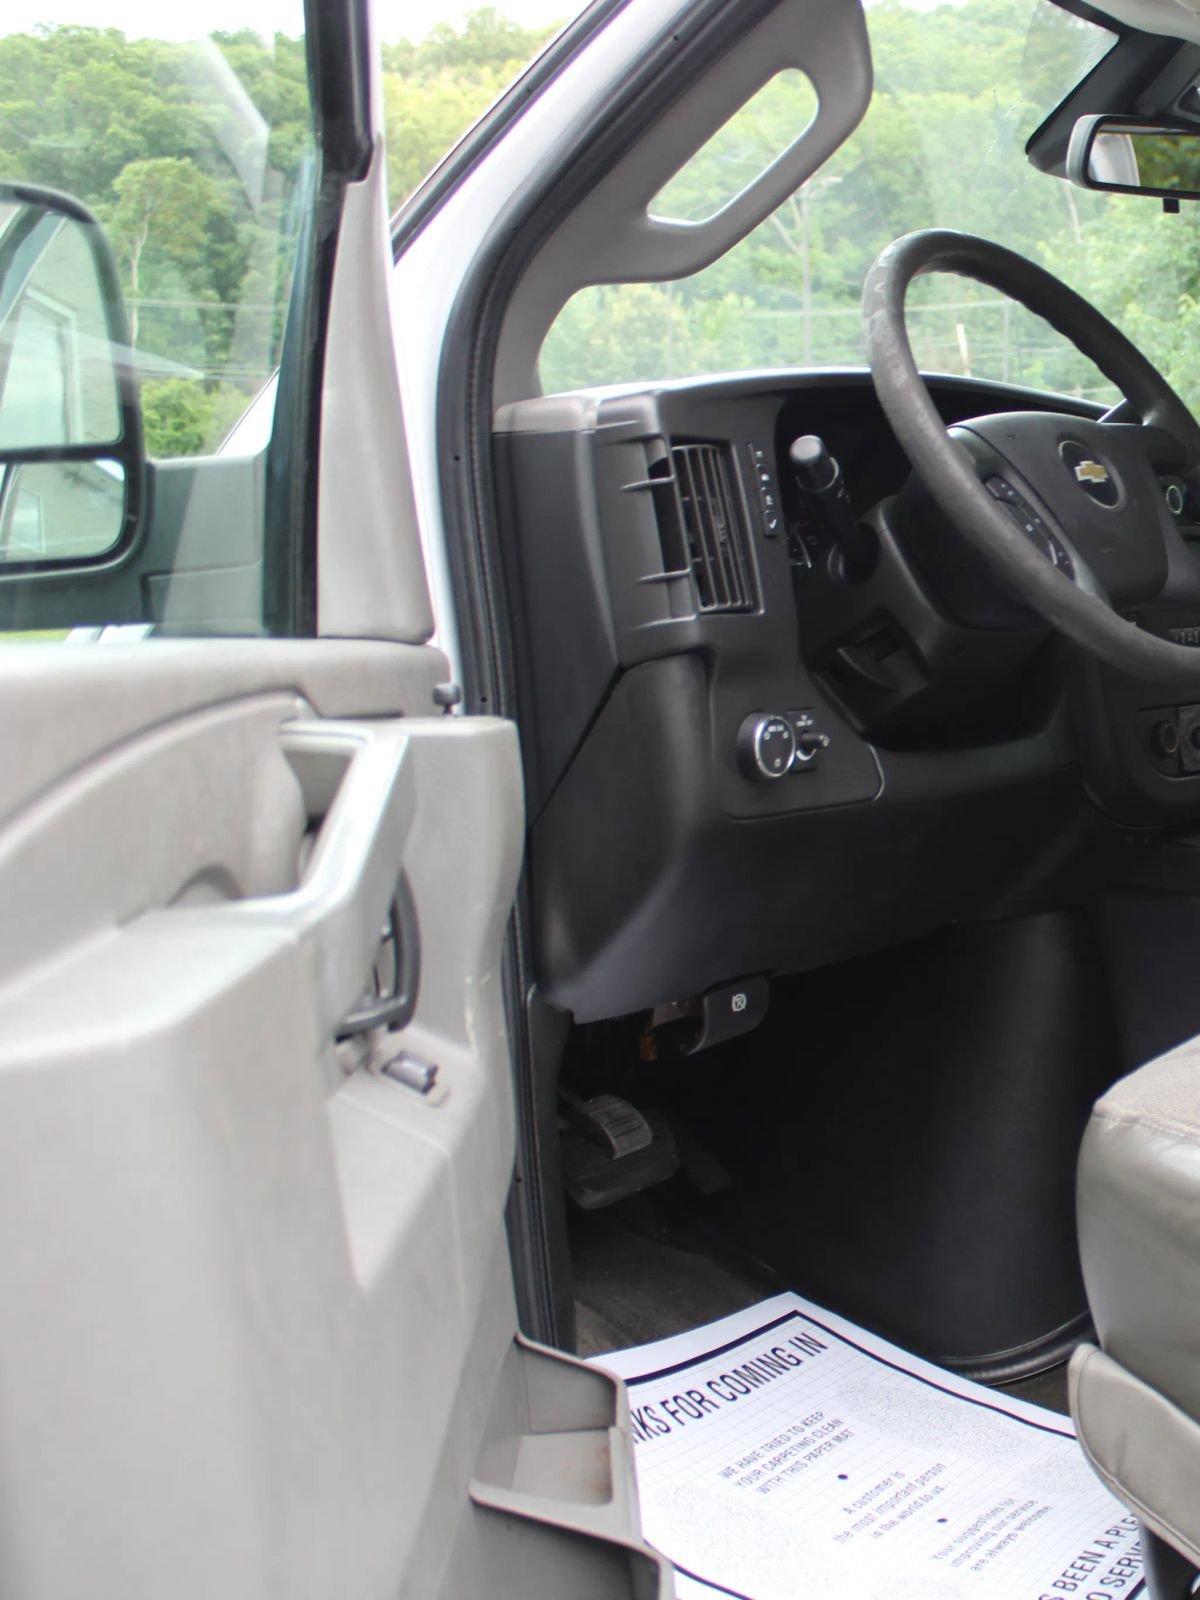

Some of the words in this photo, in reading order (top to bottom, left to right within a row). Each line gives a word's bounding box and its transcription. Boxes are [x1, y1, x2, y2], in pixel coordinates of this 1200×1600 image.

[660, 1390, 720, 1426] FOR
[706, 1347, 803, 1402] COMING
[788, 1332, 829, 1357] IN
[719, 1466, 739, 1479] WE
[736, 1450, 765, 1468] HAVE
[760, 1434, 791, 1453] TRIED
[787, 1425, 805, 1436] TO
[801, 1411, 825, 1427] KEEP
[735, 1468, 766, 1487] YOUR
[762, 1437, 816, 1471] CARPETING
[811, 1418, 844, 1438] CLEAN
[755, 1474, 786, 1494] WITH
[781, 1460, 808, 1477] THIS
[803, 1441, 836, 1462] PAPER
[832, 1429, 855, 1443] MAT
[851, 1512, 877, 1531] most
[874, 1482, 918, 1515] important
[915, 1463, 946, 1486] person
[852, 1478, 894, 1509] customer
[951, 1532, 998, 1568] improving
[1052, 1550, 1106, 1592] BEEN
[1093, 1540, 1120, 1550] A
